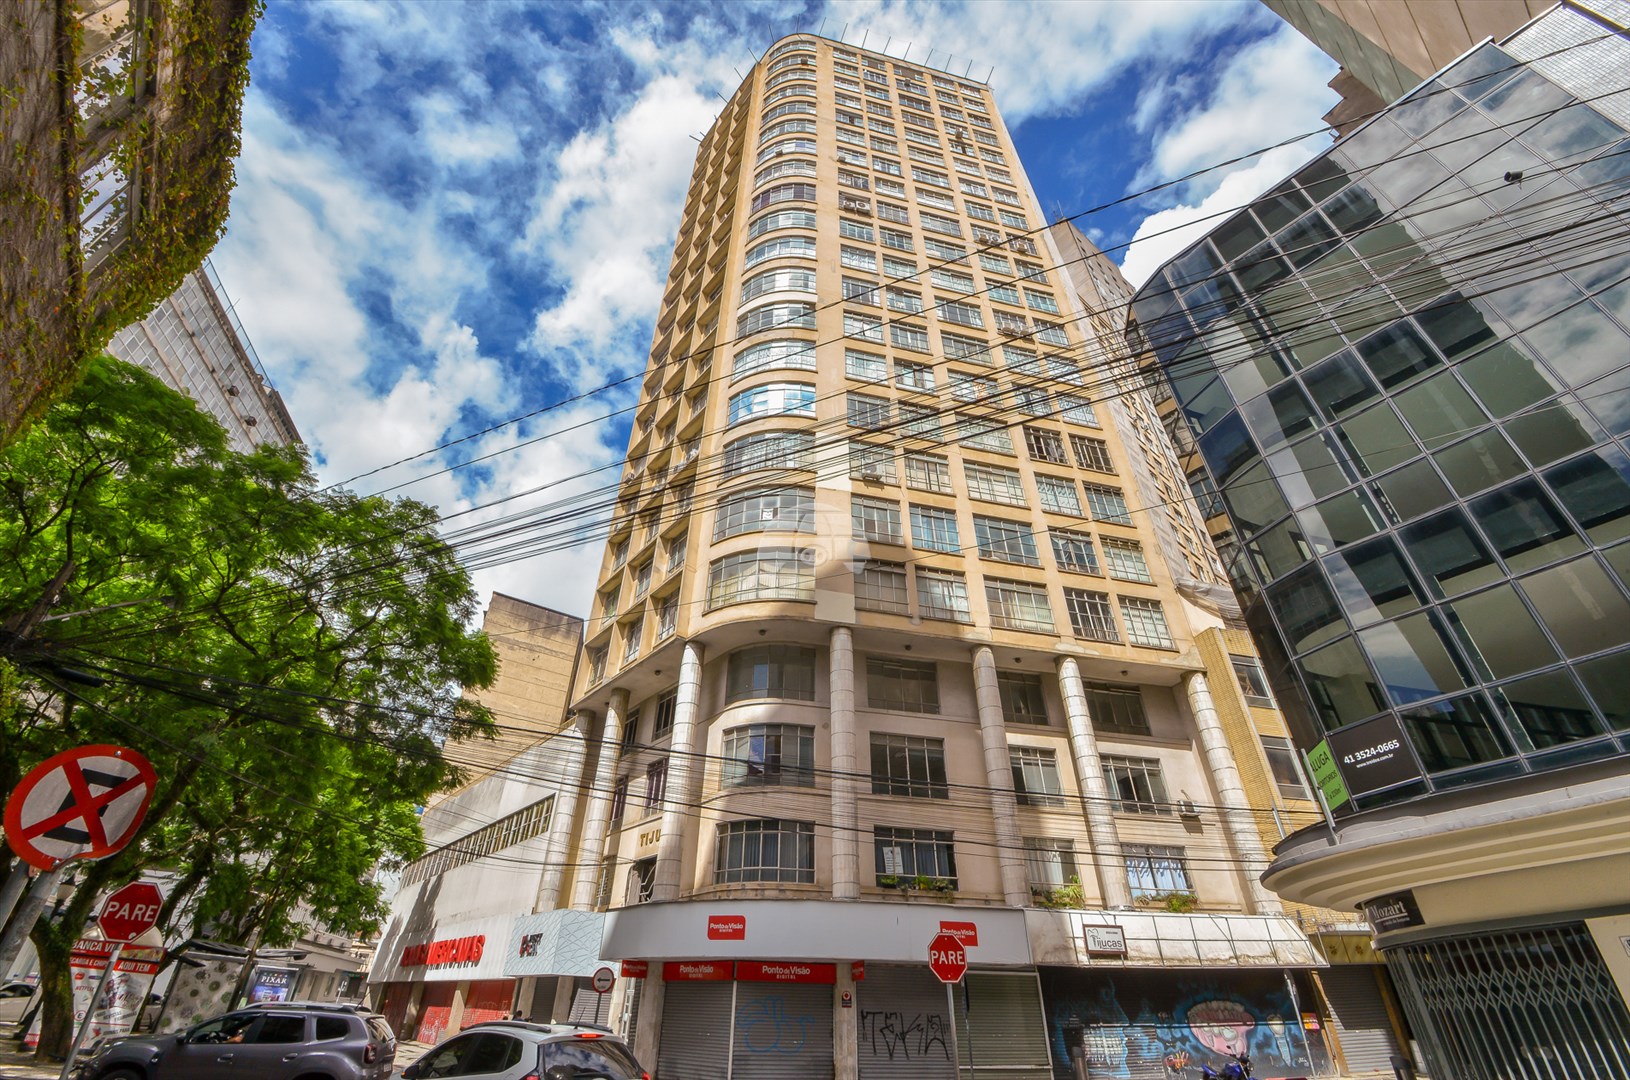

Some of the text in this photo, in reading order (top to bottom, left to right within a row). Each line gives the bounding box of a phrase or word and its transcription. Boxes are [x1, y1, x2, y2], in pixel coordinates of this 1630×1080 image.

[1344, 739, 1400, 764] 41 3524-0665
[103, 901, 158, 922] PARE
[931, 950, 965, 965] PARE
[136, 963, 151, 972] TEM
[680, 965, 695, 973] Ponto
[699, 965, 714, 973] Visão
[762, 966, 784, 974] Ponto
[789, 966, 810, 975] Visão
[261, 976, 287, 984] PIXAR
